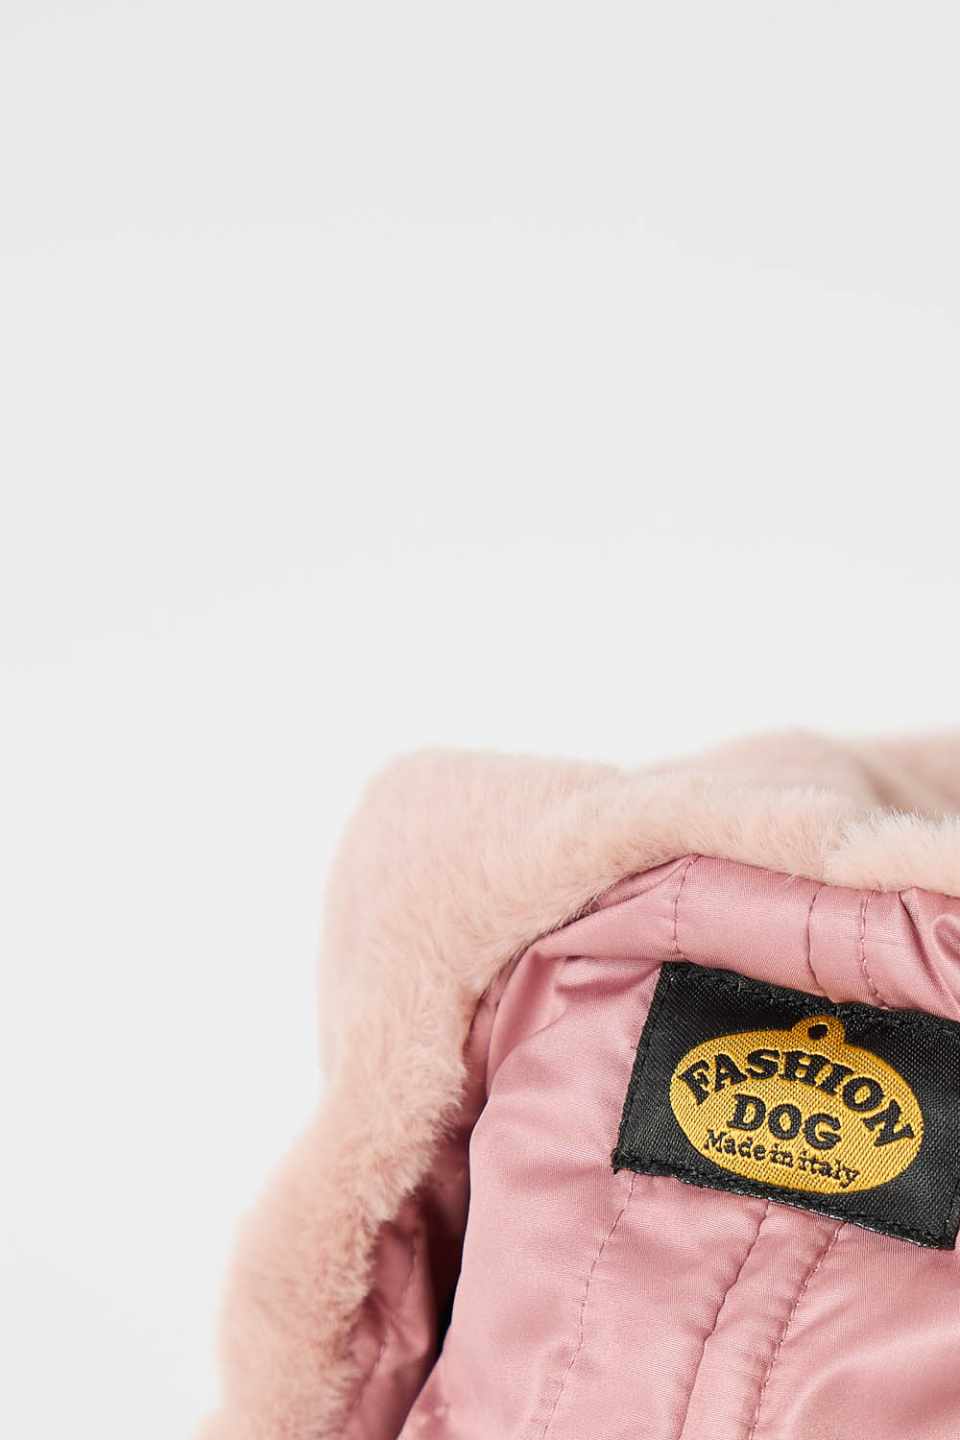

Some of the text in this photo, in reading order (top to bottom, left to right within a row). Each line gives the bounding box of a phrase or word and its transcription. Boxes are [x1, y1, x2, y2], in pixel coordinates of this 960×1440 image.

[678, 1049, 914, 1147] FASHION
[727, 1093, 841, 1150] DOG
[704, 1129, 766, 1161] Made
[768, 1143, 794, 1168] in
